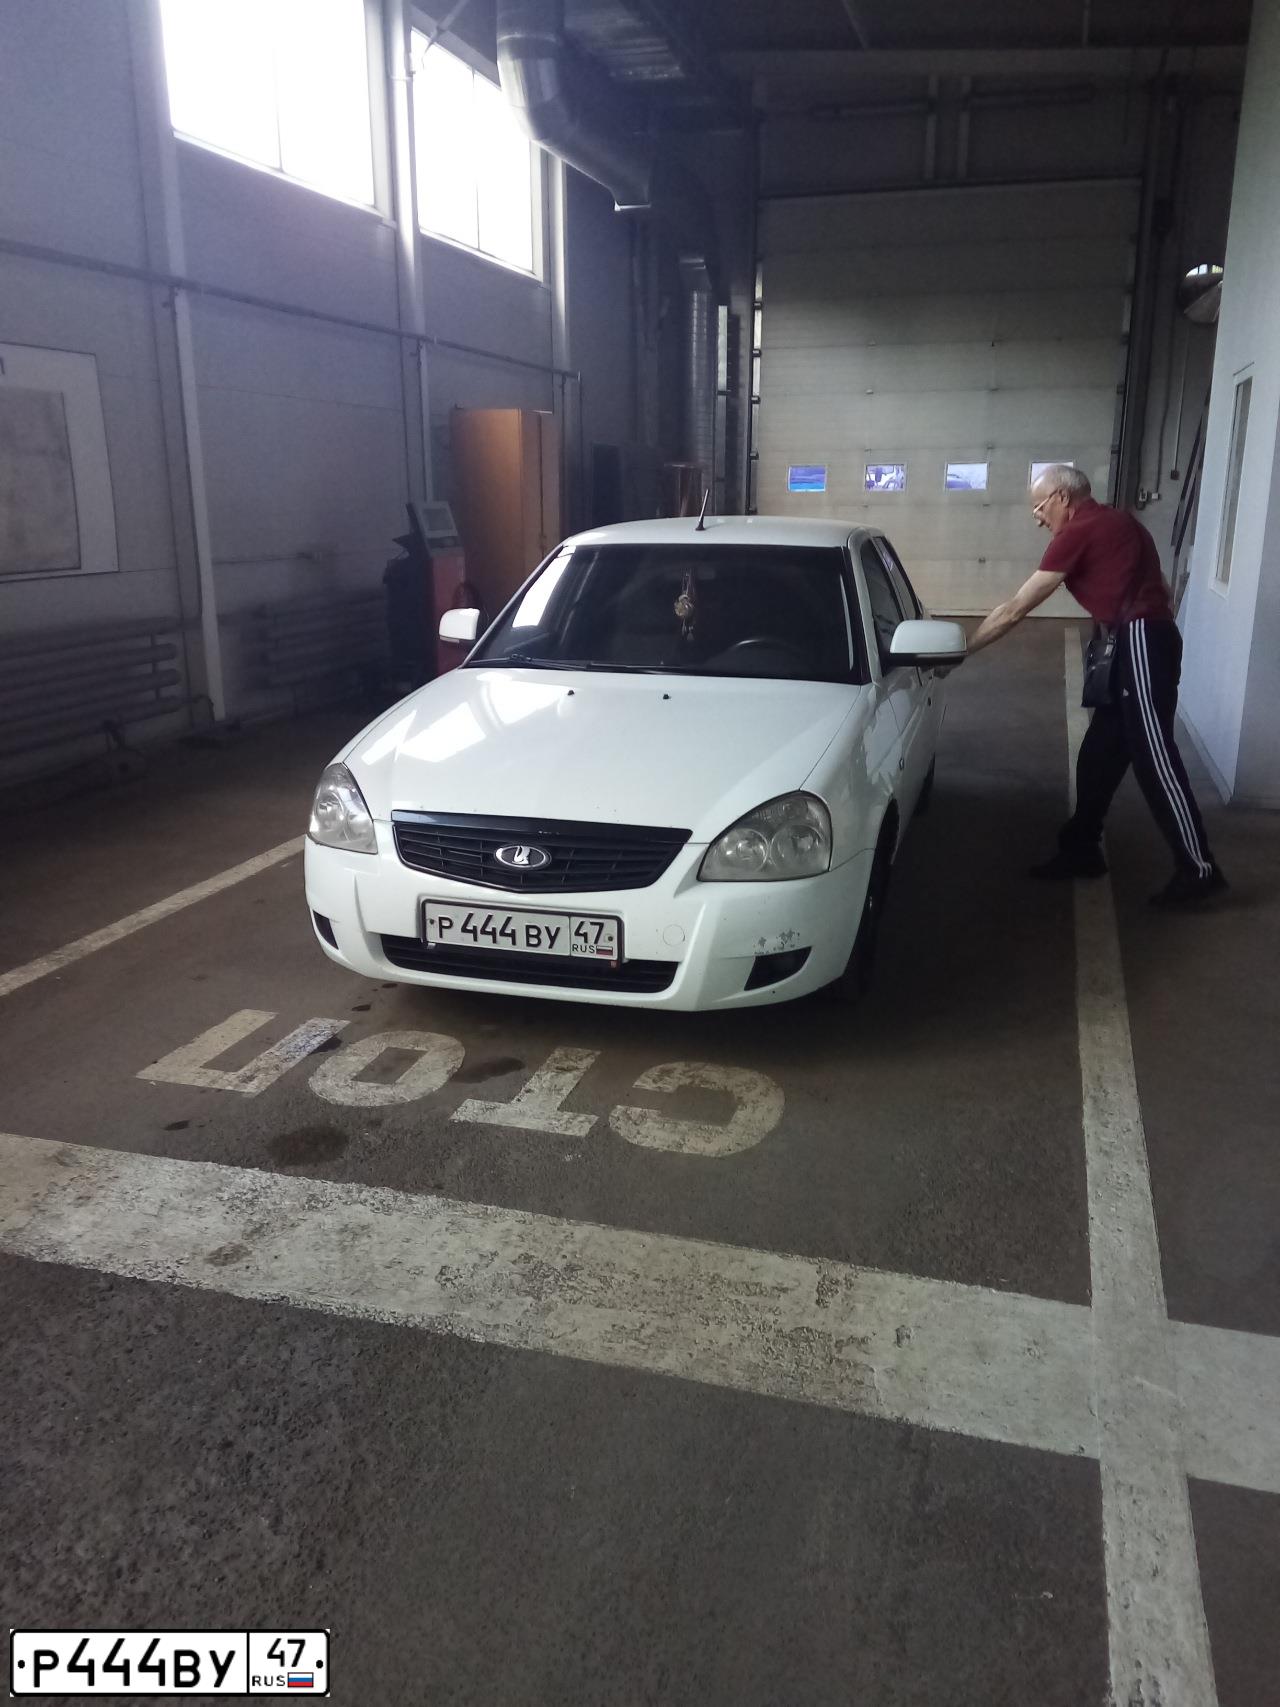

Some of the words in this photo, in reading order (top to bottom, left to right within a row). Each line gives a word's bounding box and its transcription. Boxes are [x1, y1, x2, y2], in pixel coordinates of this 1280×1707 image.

[573, 920, 605, 944] 47
[571, 944, 595, 954] RUS
[135, 1008, 785, 1157] СТОП
